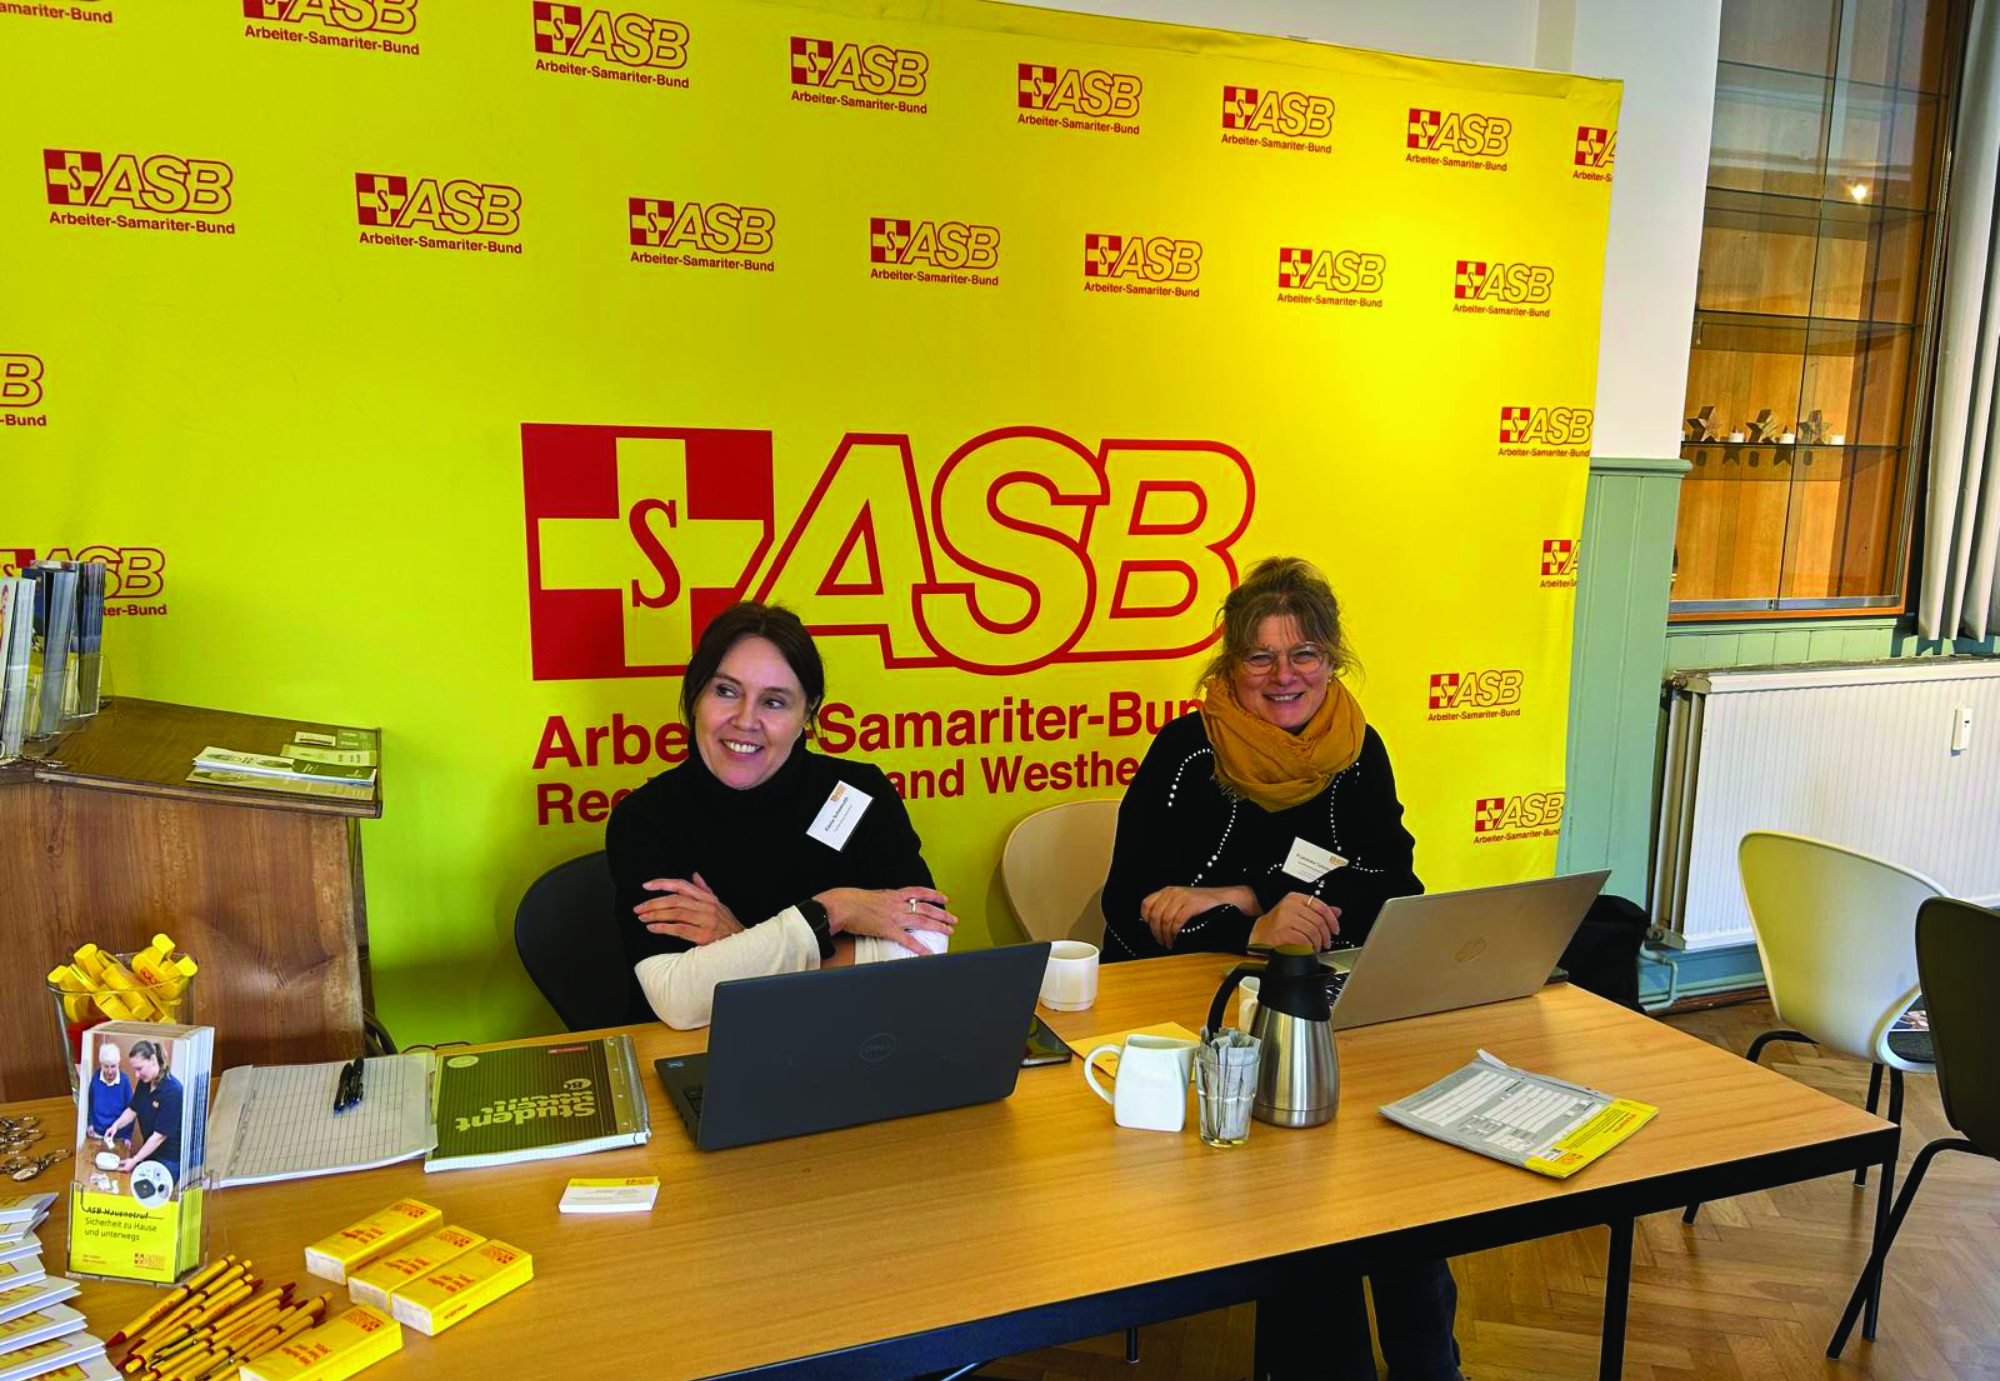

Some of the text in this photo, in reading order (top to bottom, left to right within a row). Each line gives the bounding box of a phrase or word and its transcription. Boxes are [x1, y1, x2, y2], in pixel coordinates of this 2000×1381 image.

[245, 25, 419, 55] Arbeiter-Samariter-Bund
[571, 10, 689, 69] ASB
[536, 59, 689, 88] Arbeiter-Samariter-Bund
[824, 44, 929, 97] ASB
[791, 90, 928, 114] Arbeiter-Samariter-Bund
[1047, 69, 1142, 118] ASB
[1018, 114, 1140, 135] Arbeiter-Samariter-Bund
[1247, 91, 1334, 138] ASB
[1221, 133, 1332, 154] Arbeiter-Samariter-Bund
[1430, 114, 1511, 156] ASB
[1406, 153, 1507, 171] Arbeiter-Samariter-Bund
[88, 154, 233, 214] ASB
[395, 179, 522, 235] ASB
[50, 212, 235, 234] Arbeiter-Samariter-Bund
[664, 203, 775, 255] ASB
[359, 232, 522, 254] Arbeiter-Samariter-Bund
[900, 220, 1000, 270] ASB
[631, 252, 774, 272] Arbeiter-Samariter-Bund
[1110, 236, 1202, 283] ASB
[1301, 250, 1385, 294] ASB
[871, 268, 998, 286] Arbeiter-Samariter-Bund
[1084, 282, 1200, 298] Arbeiter-Samariter-Bund
[1476, 263, 1554, 304] ASB
[1277, 293, 1383, 308] Arbeiter-Samariter-Bund
[1454, 303, 1550, 317] Arbeiter-Samariter-Bund
[1519, 406, 1594, 446] ASB
[753, 425, 1255, 676] ASB
[1453, 670, 1523, 708] ASB
[455, 1102, 596, 1132] Student
[84, 1228, 140, 1242] und unterwegs
[85, 1217, 122, 1229] Sicherheit
[134, 1221, 157, 1232] Hause
